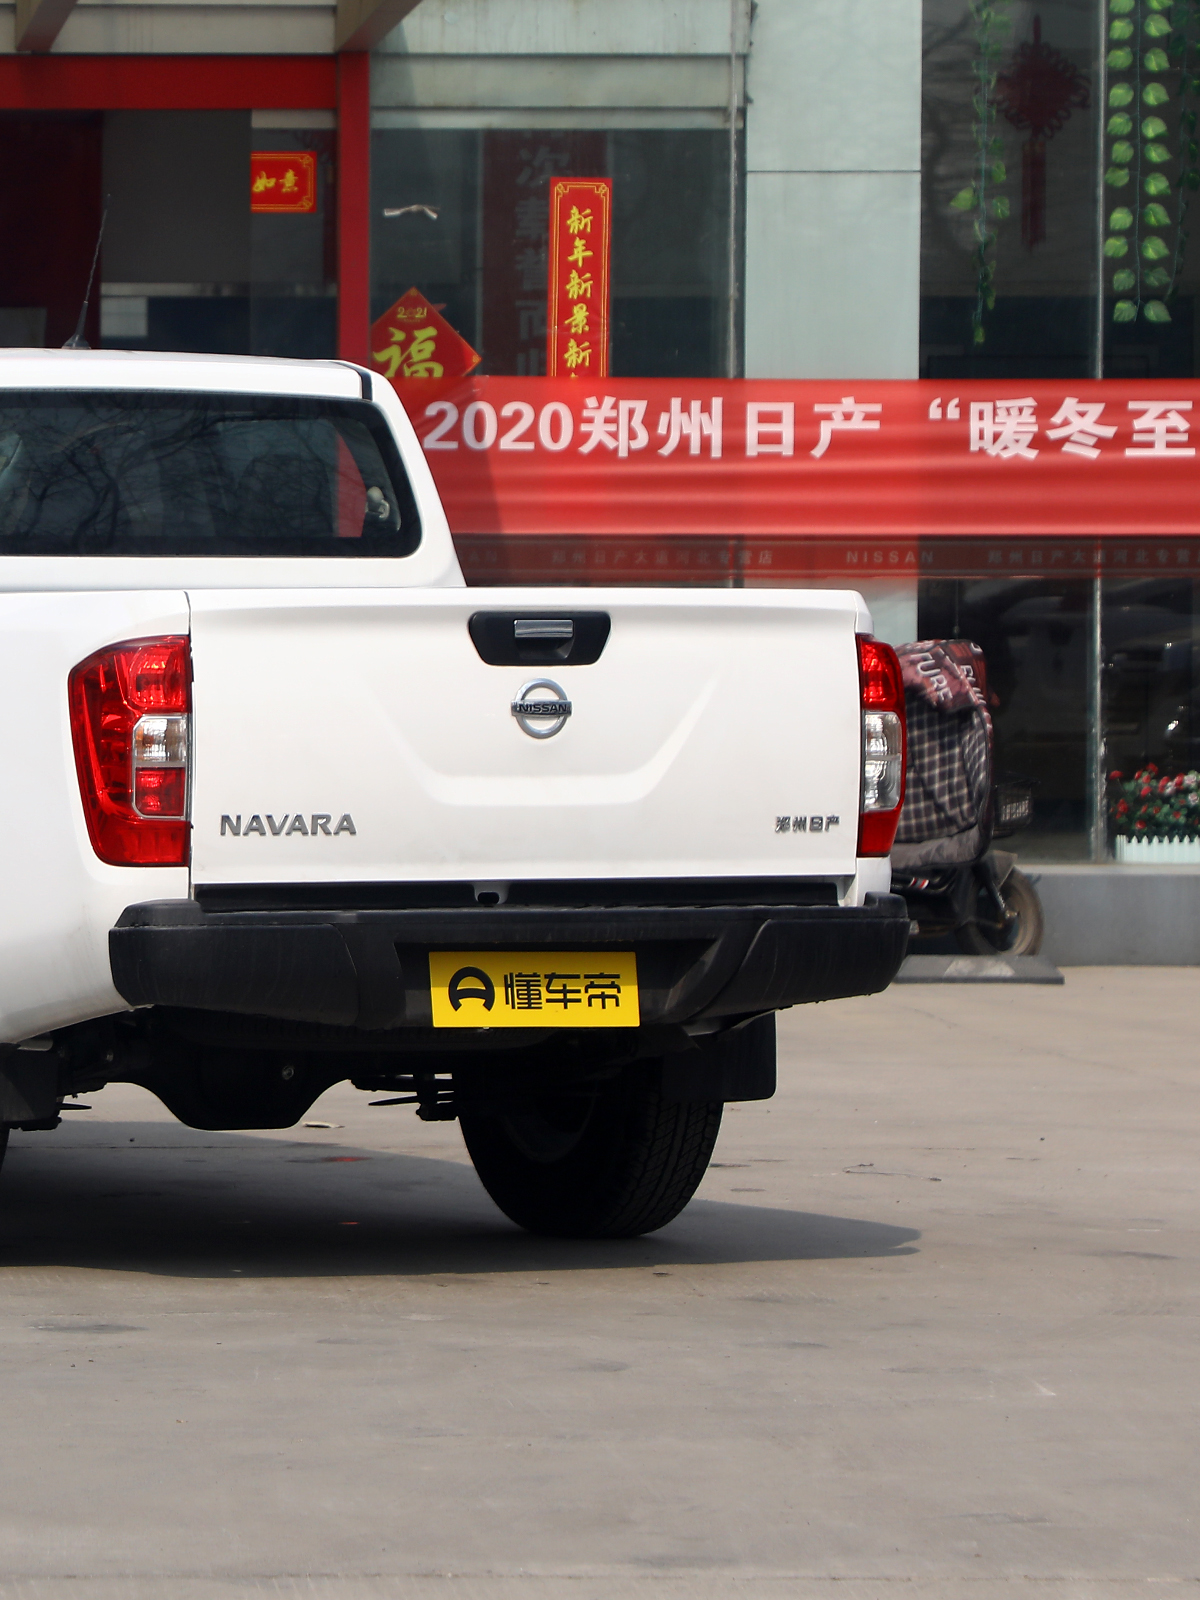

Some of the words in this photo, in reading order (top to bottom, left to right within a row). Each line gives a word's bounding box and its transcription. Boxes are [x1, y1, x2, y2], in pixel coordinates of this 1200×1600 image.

[251, 168, 300, 193] 如意
[563, 203, 594, 377] 新年新景新
[372, 325, 444, 378] 福
[845, 550, 935, 564] NISSAN
[987, 549, 1200, 565] 郑州日产大道河北专营
[515, 702, 568, 715] NISSAN
[219, 813, 357, 837] NAVARA
[774, 813, 842, 834] 郑州日产
[503, 971, 621, 1010] 懂车帝
